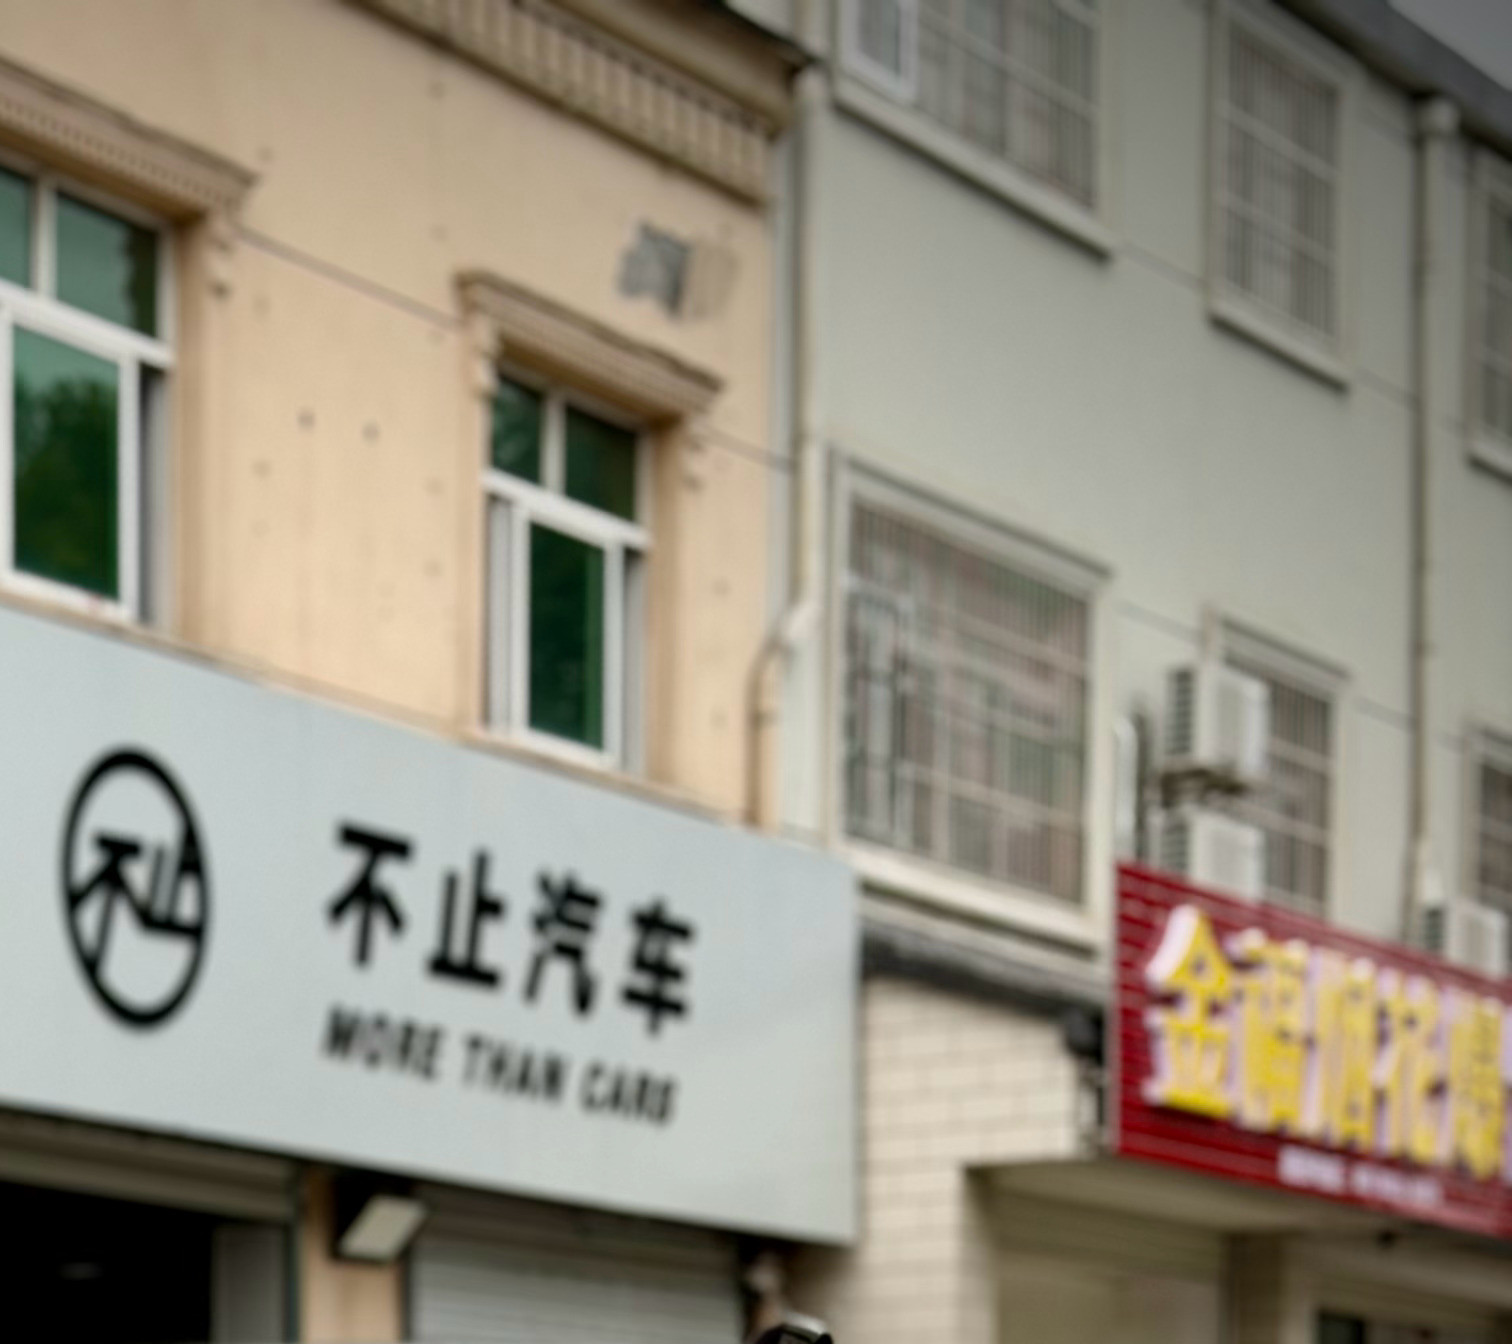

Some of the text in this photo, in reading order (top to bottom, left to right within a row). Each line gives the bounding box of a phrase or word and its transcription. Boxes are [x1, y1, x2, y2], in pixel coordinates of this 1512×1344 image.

[328, 823, 694, 1032] 不止汽车
[323, 1005, 443, 1081] MORE
[464, 1033, 567, 1102] THAN
